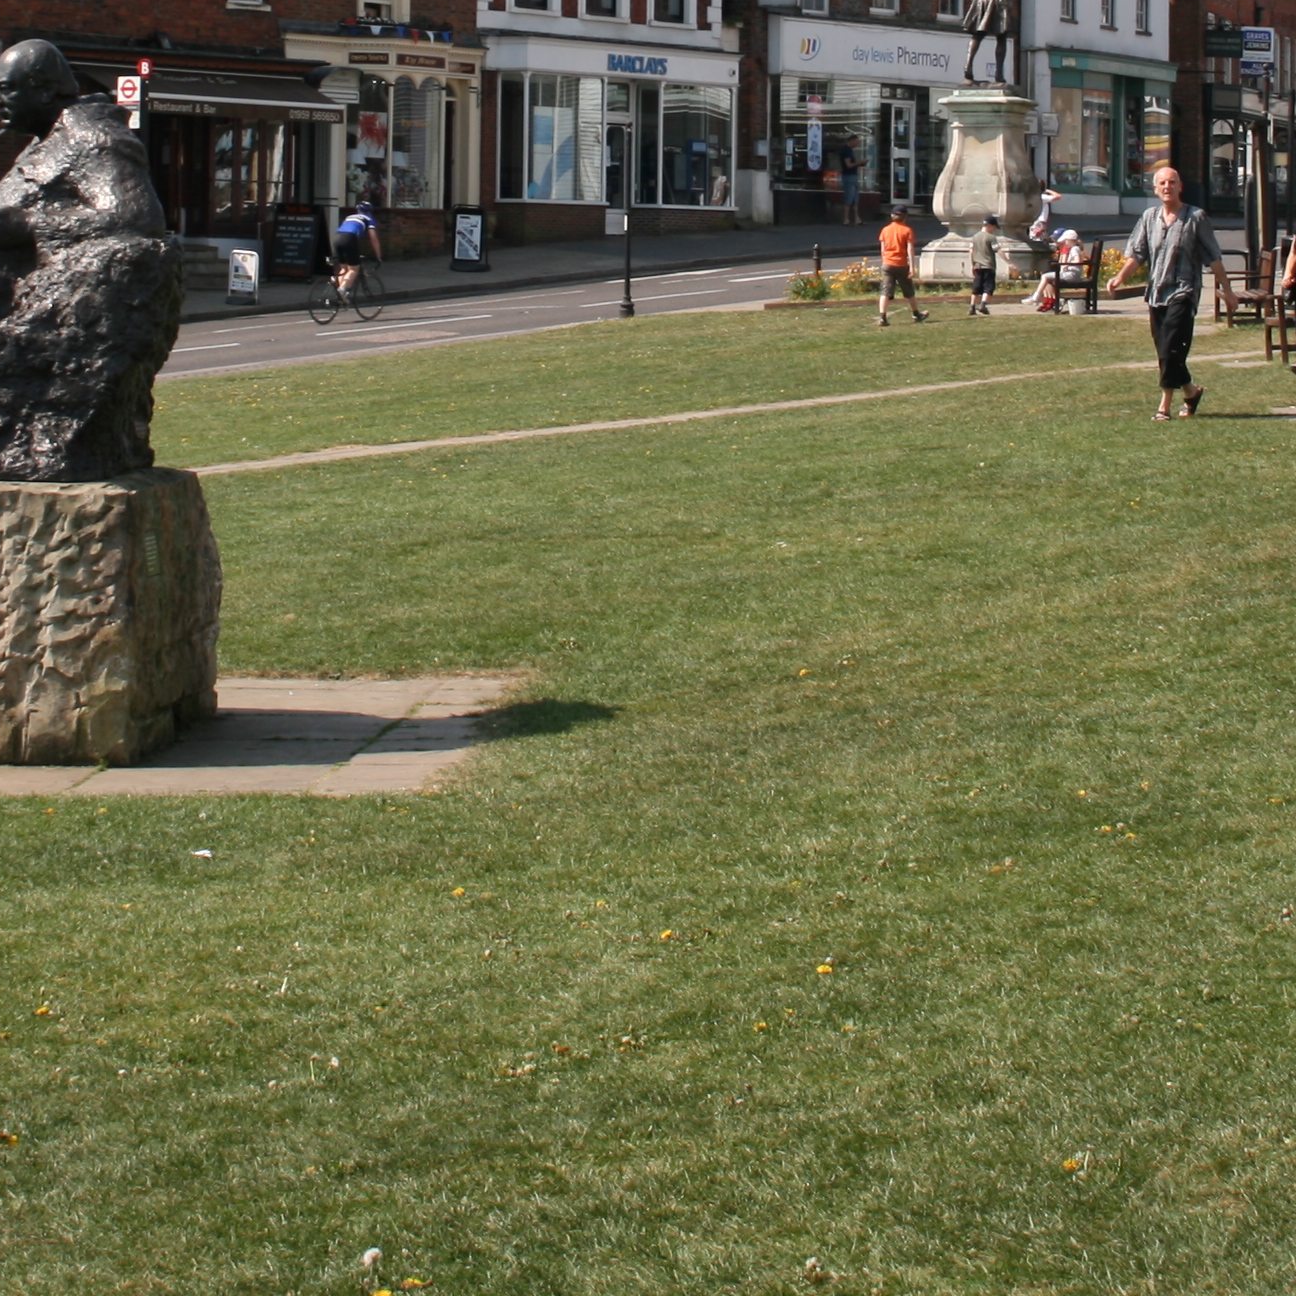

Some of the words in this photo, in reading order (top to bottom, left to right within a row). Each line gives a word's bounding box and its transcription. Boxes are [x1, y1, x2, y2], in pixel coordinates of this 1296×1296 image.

[607, 53, 668, 75] BARCLAYS
[852, 45, 871, 65] day
[871, 47, 894, 64] lewis
[896, 46, 951, 72] Pharmacy
[140, 61, 150, 75] B
[153, 101, 193, 113] Restaurant
[194, 105, 201, 113] &
[204, 104, 216, 114] Bar
